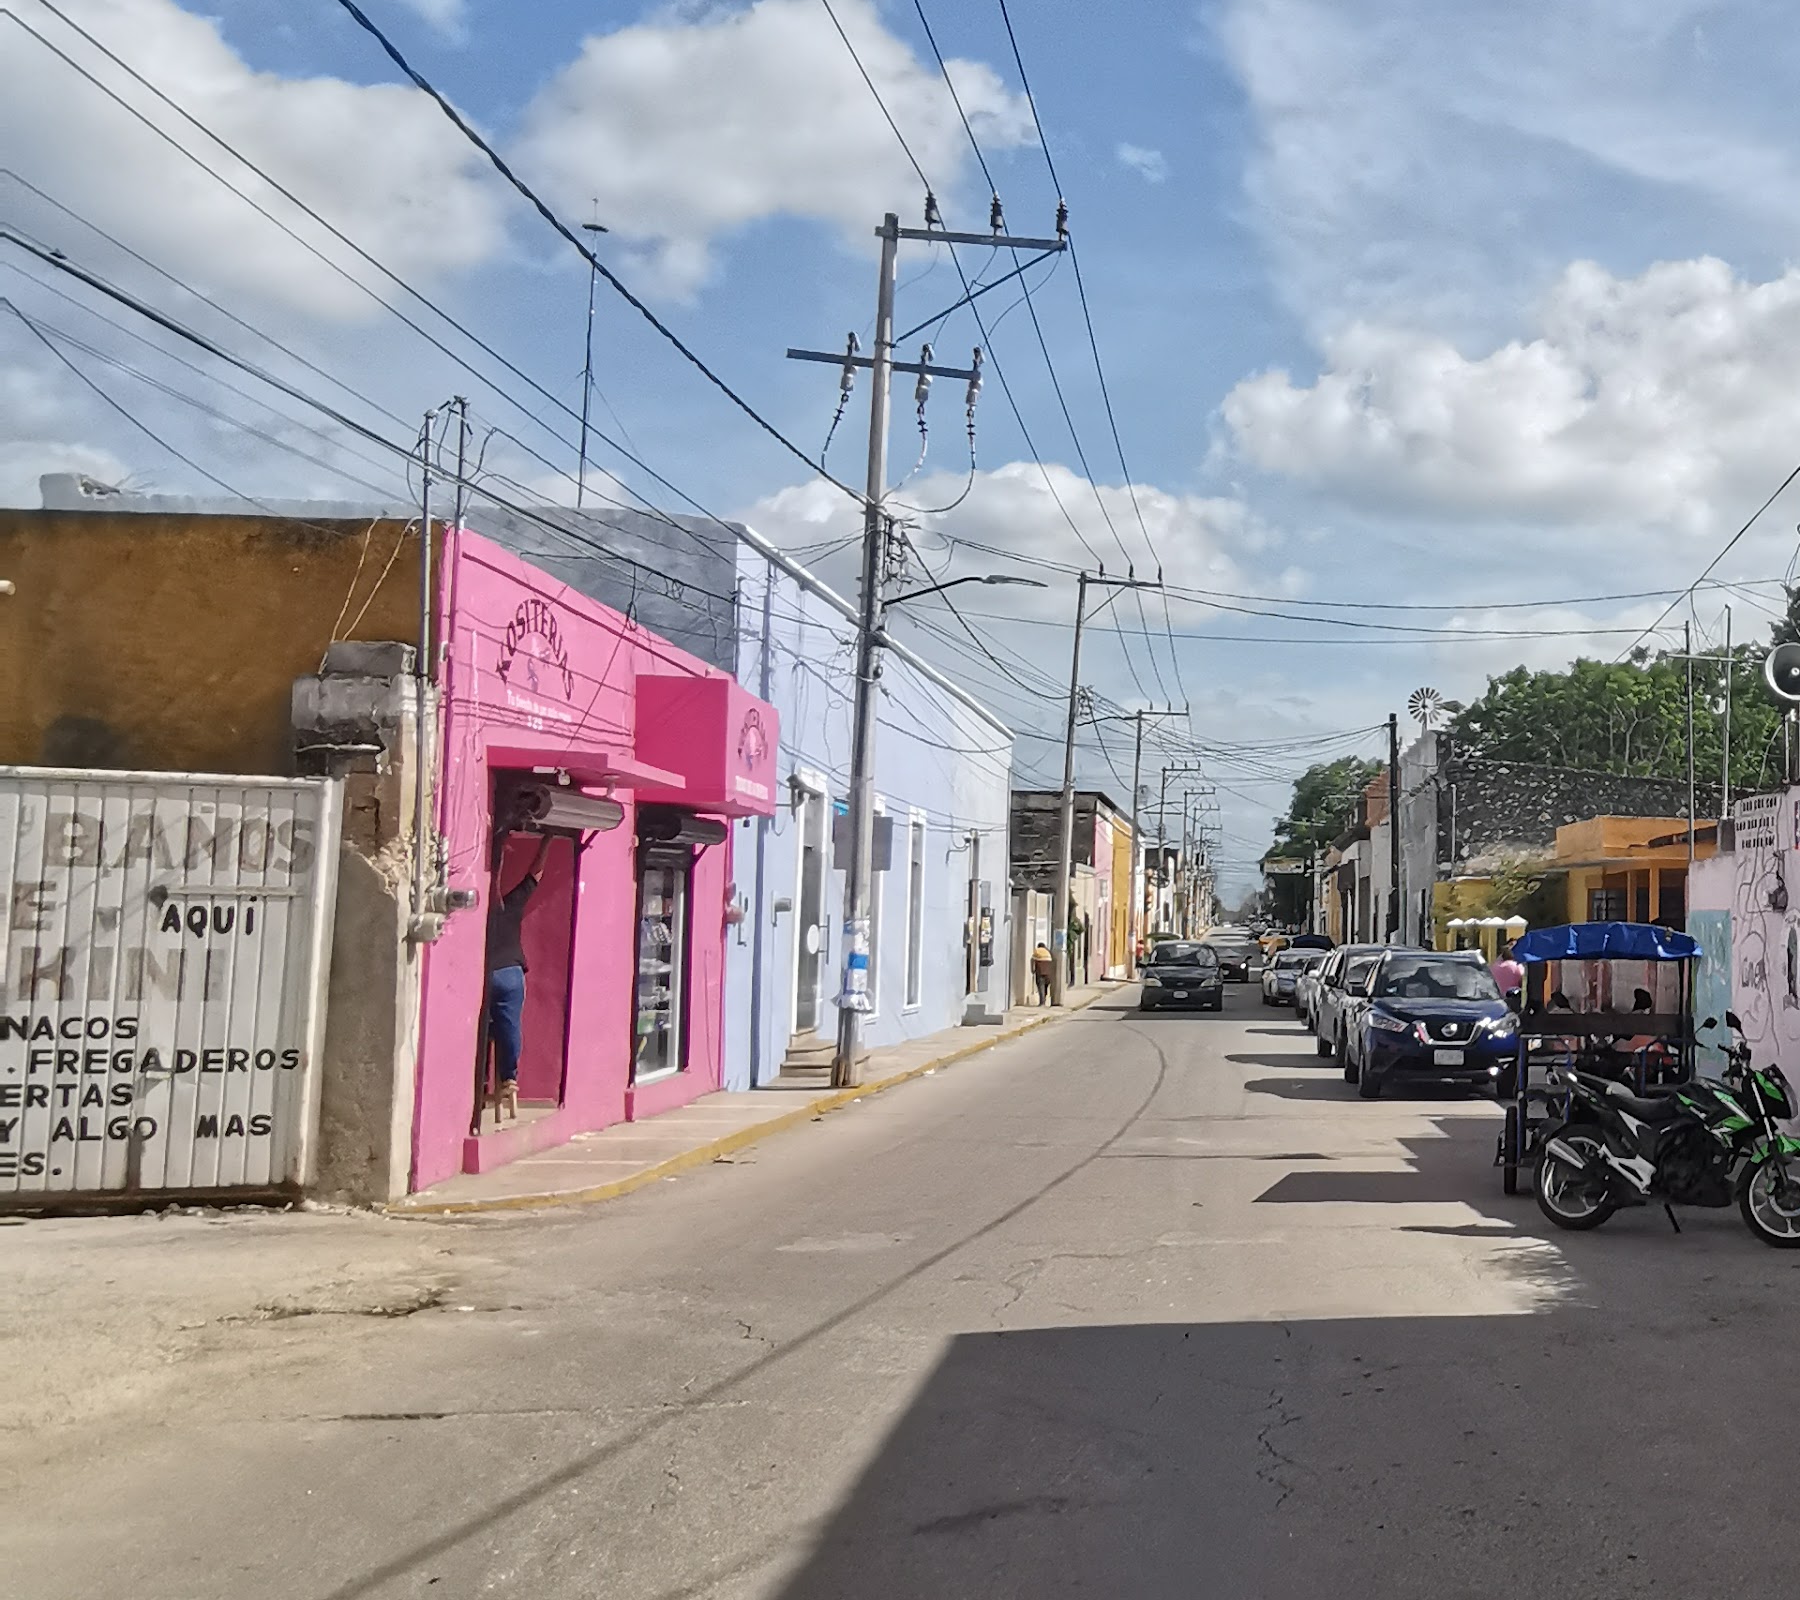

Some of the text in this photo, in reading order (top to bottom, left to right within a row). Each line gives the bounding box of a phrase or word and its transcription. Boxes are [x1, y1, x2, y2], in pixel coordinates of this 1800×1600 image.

[29, 1048, 300, 1075] FREGADEROS
[0, 1083, 134, 1108] ERTAS
[52, 1114, 158, 1143] ALGO
[196, 1114, 272, 1139] MAS
